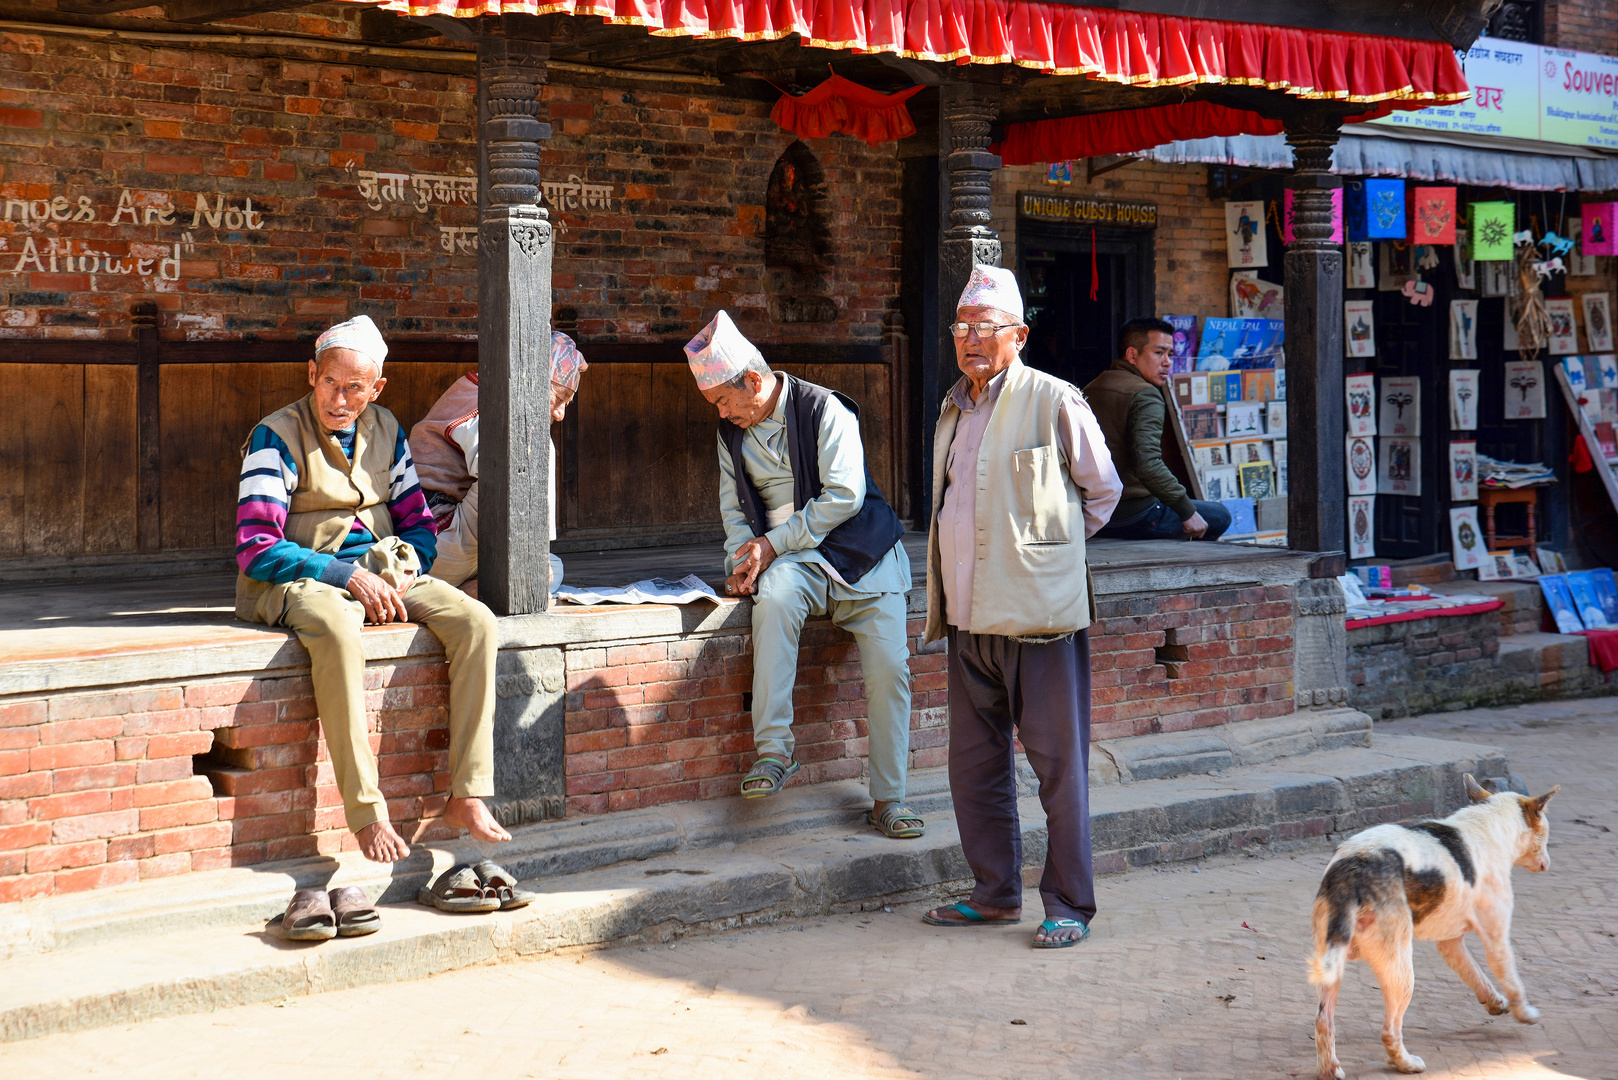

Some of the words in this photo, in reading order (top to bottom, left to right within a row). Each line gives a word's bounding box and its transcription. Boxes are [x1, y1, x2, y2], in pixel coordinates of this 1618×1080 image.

[1475, 86, 1504, 110] घर
[107, 189, 176, 226] Are
[189, 193, 265, 230] Not
[1023, 195, 1071, 218] UNIQUE
[1074, 200, 1113, 222] GUEST
[1116, 203, 1157, 224] HOUSE
[1208, 320, 1239, 331] NEPAL
[1241, 321, 1261, 331] EPAL
[1267, 321, 1284, 331] NEP
